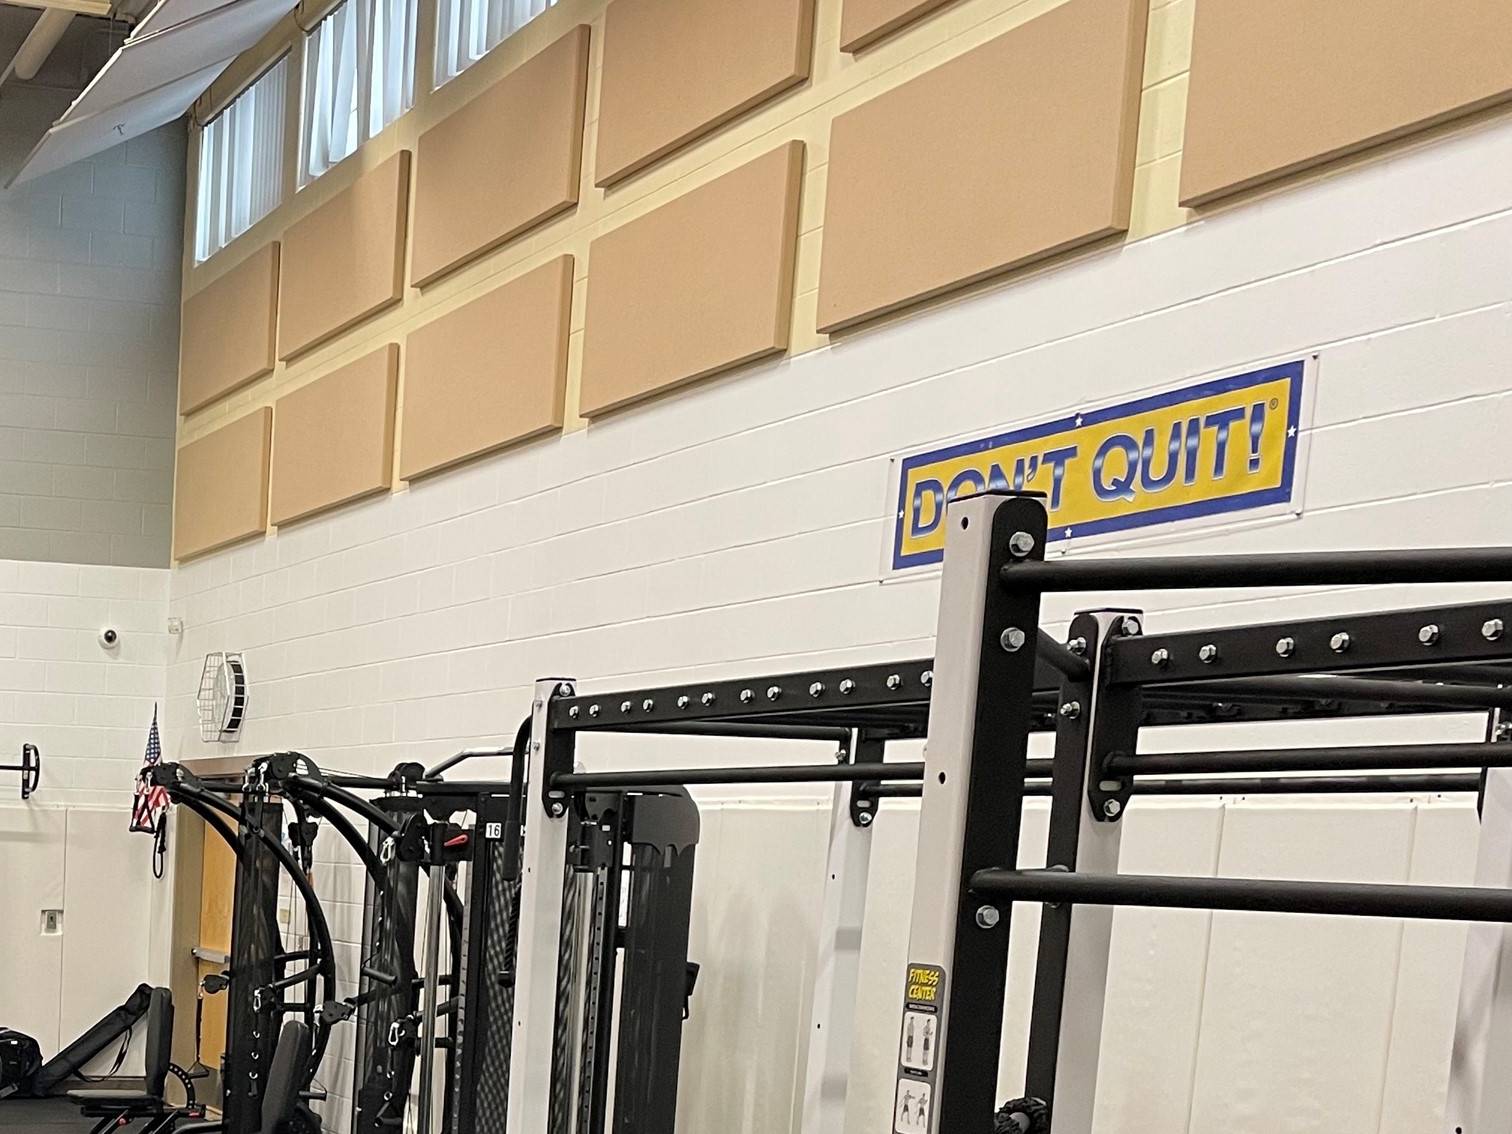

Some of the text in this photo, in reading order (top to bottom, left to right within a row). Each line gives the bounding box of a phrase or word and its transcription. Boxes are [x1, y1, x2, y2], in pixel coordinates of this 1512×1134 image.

[1092, 402, 1266, 502] QUIT!
[488, 824, 500, 837] 16
[909, 968, 939, 986] FITNESS
[909, 985, 936, 1001] CENTER
